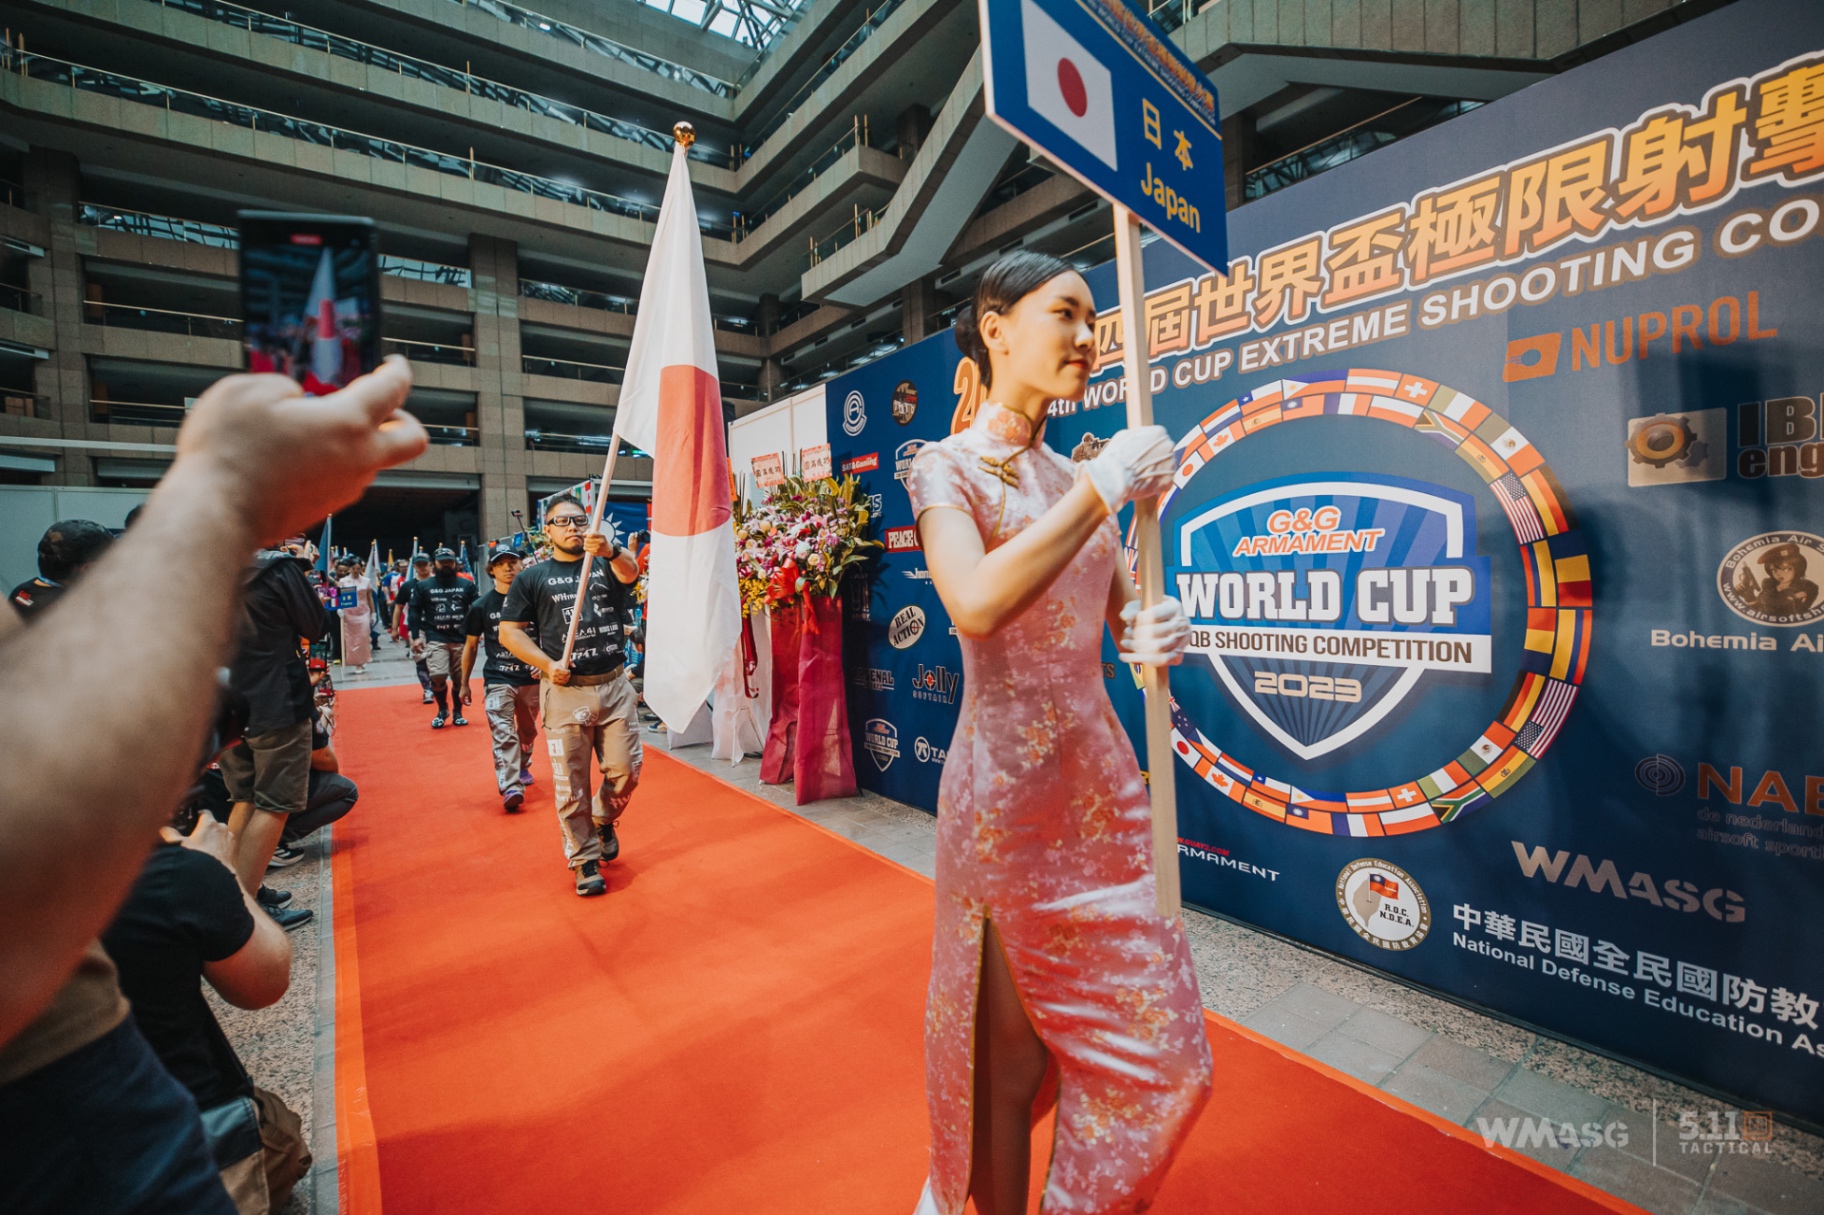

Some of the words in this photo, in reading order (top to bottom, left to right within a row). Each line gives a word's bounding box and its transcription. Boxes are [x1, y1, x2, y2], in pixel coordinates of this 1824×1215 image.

[1142, 98, 1194, 171] 日本
[1140, 161, 1201, 233] Japan
[1083, 367, 1167, 409] WORD
[1173, 352, 1232, 391] CUP
[1241, 303, 1407, 371] EXTREME
[1422, 231, 1695, 326] SHOOTING
[1720, 199, 1820, 254] CO
[1571, 290, 1778, 372] NUPROL
[1737, 392, 1824, 449] IB
[1267, 506, 1340, 533] G&G
[1234, 530, 1383, 556] ARMAMENT
[1725, 535, 1781, 569] Bohemia
[1787, 534, 1812, 546] Air
[547, 576, 574, 586] G&G
[1176, 570, 1342, 622] WORLD
[1357, 567, 1474, 626] CUP
[892, 616, 925, 647] ACTION
[894, 605, 917, 629] REAL
[1215, 630, 1308, 655] SHOOTING
[1313, 634, 1473, 664] COMPETITION
[1651, 629, 1777, 650] Bohemia
[912, 664, 960, 704] Jolly
[1254, 671, 1362, 703] 2023
[1697, 806, 1721, 823] de
[1696, 827, 1760, 849] airsoft
[1374, 860, 1405, 878] Education
[1404, 878, 1428, 914] Association
[1511, 840, 1746, 924] WMASG
[1379, 910, 1414, 928] N.D.E.A.
[1384, 903, 1409, 917] R.O.C.
[1453, 903, 1819, 1030] 中華民國全民國防教
[1453, 931, 1535, 970] National
[1541, 958, 1636, 1000] Defense
[1644, 988, 1783, 1045] Education
